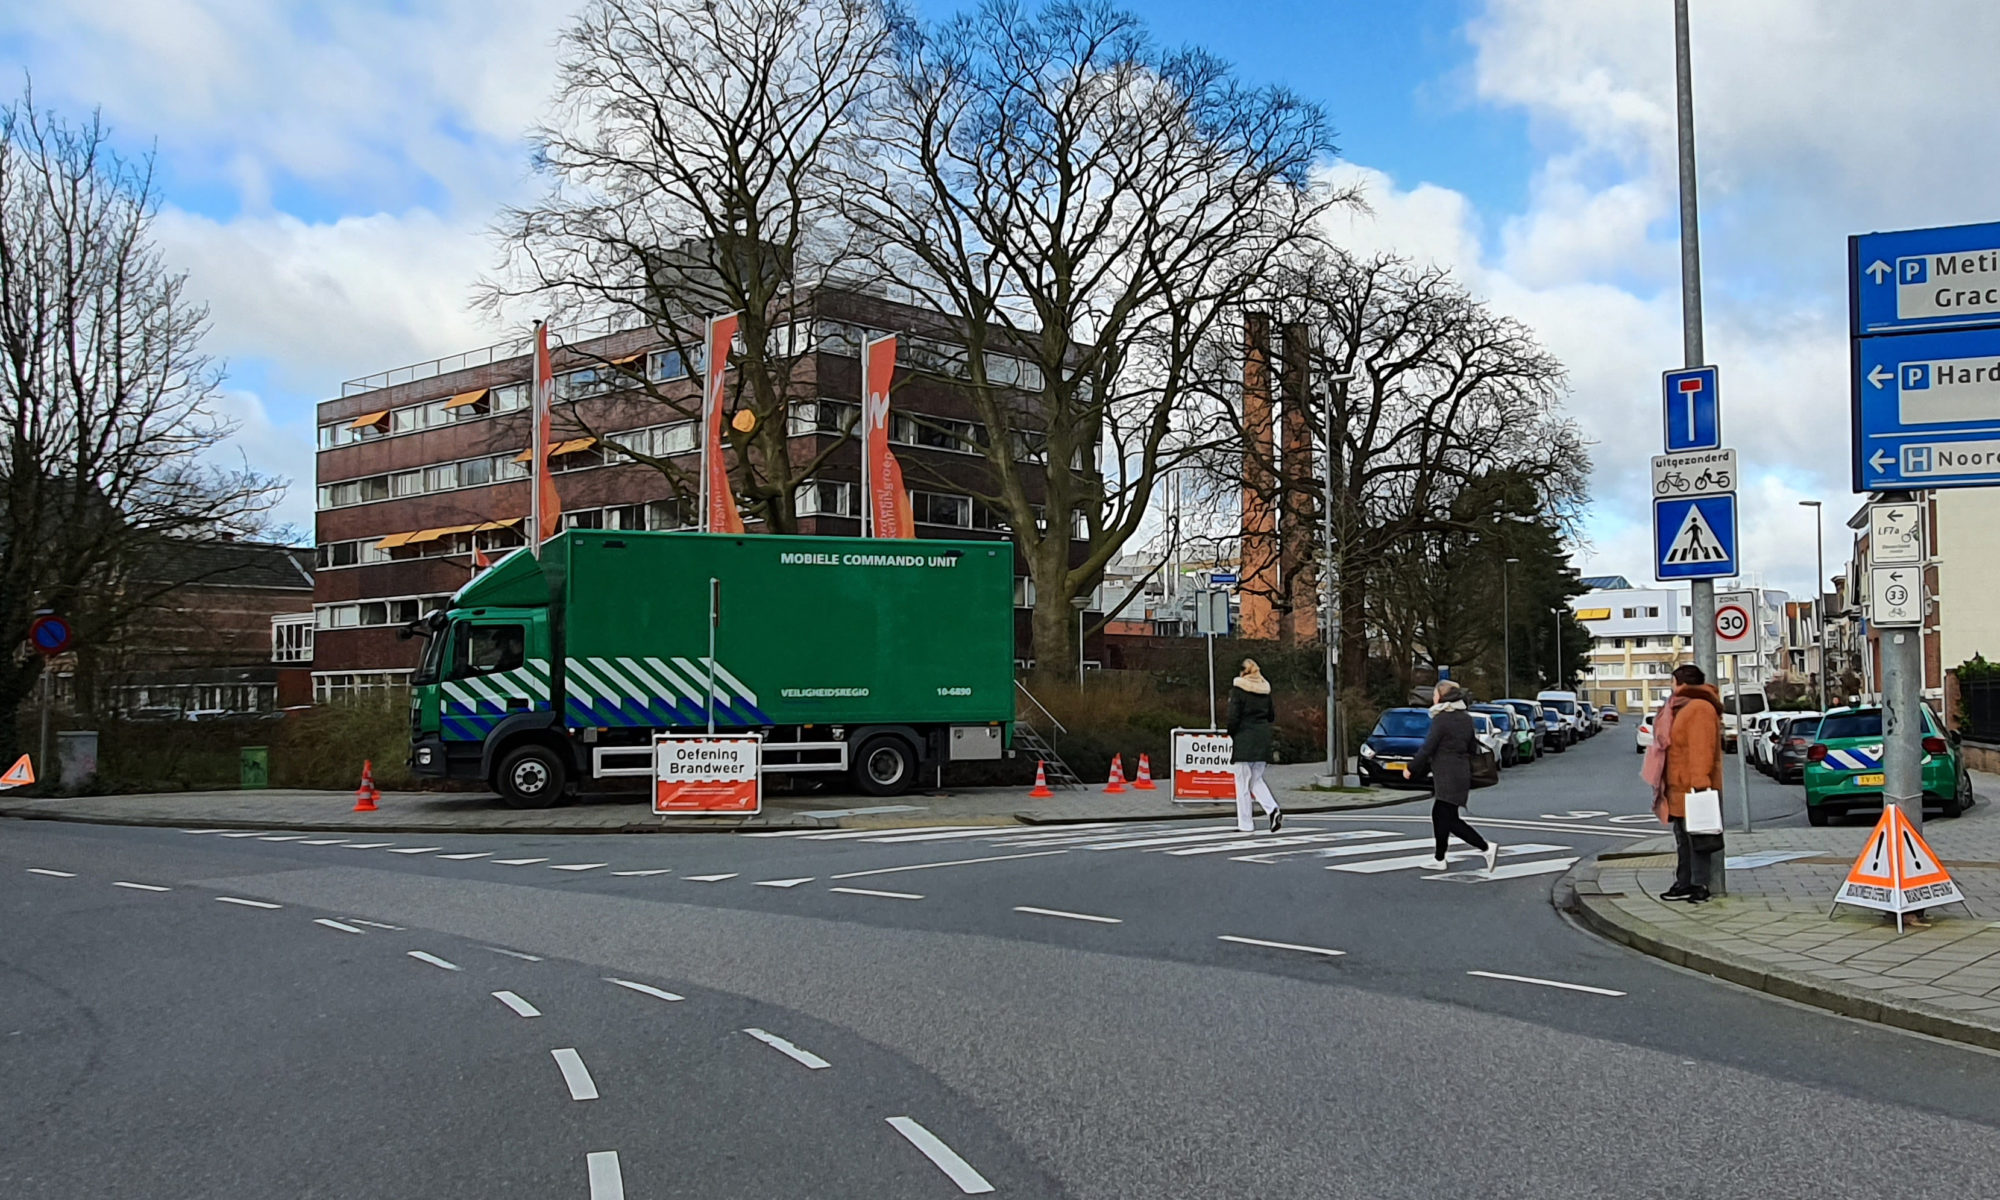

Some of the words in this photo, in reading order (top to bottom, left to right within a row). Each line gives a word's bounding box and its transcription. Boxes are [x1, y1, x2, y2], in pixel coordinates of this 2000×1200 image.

[1905, 261, 1920, 282] P
[1936, 251, 1998, 276] Meti
[1935, 288, 1998, 308] Grac
[1908, 367, 1923, 387] P
[1937, 362, 2000, 386] Hard
[1655, 452, 1730, 469] uitgezonderd
[1906, 447, 1929, 472] H
[780, 553, 839, 565] MOBIELE
[843, 555, 924, 567] COMMANDO
[928, 556, 958, 568] UNIT
[1719, 594, 1740, 603] ZONE
[1889, 590, 1905, 601] 33
[1719, 616, 1744, 631] 30
[676, 748, 738, 762] Oefening
[1191, 742, 1234, 753] Oefenin
[1185, 754, 1230, 765] Brandw
[670, 763, 745, 774] Brandweer
